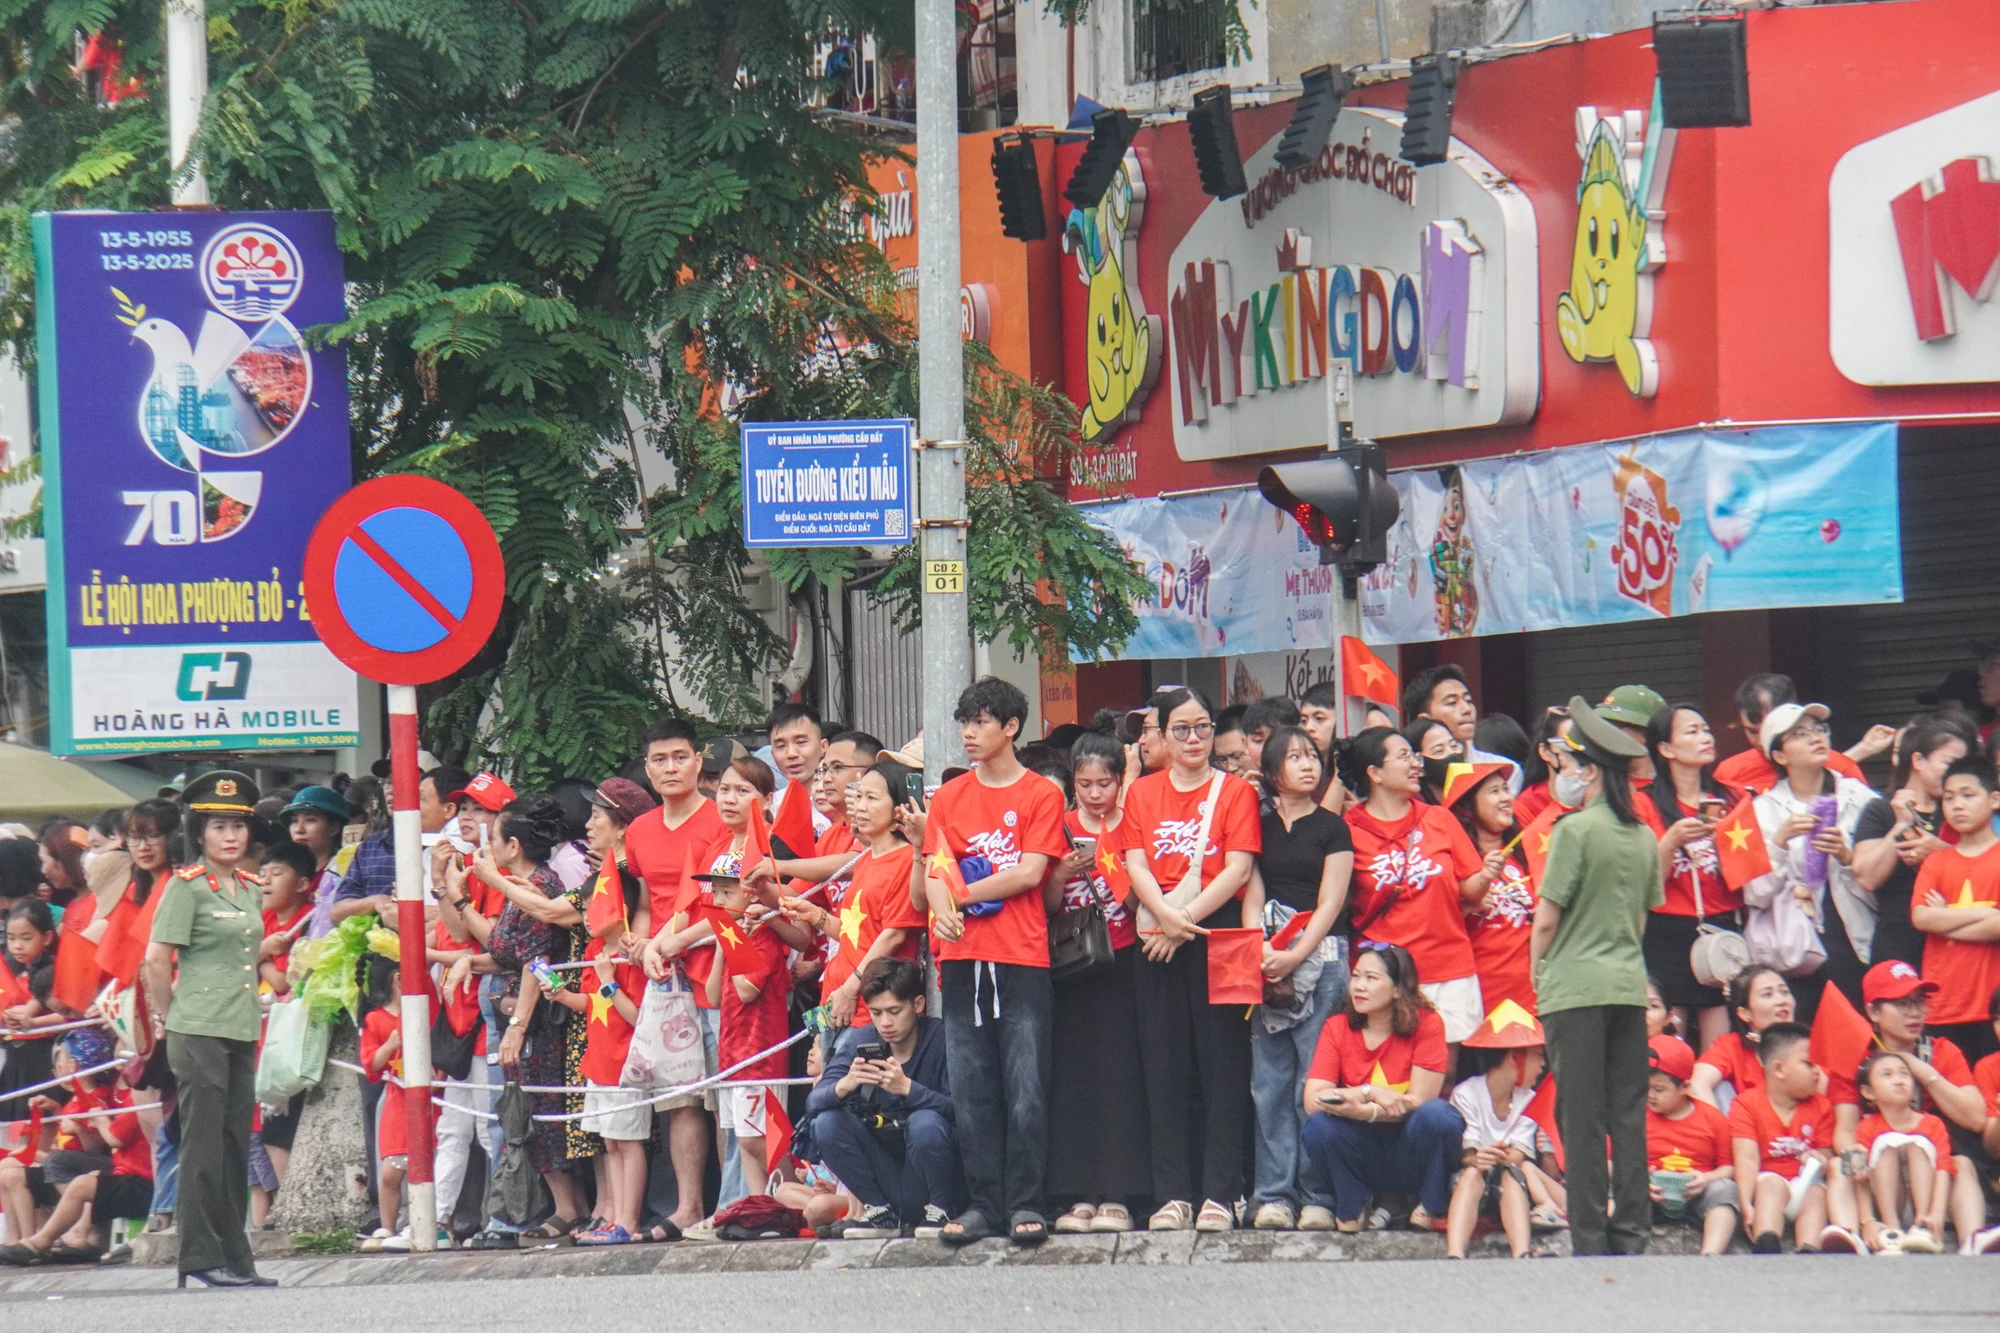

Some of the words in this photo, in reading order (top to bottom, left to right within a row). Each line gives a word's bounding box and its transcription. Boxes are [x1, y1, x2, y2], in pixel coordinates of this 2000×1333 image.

[100, 230, 193, 248] 13-5-1955
[101, 253, 194, 271] 13-5-2025
[778, 435, 792, 446] BAN
[793, 433, 812, 445] NHÂN
[813, 432, 827, 445] DÂN
[796, 459, 837, 503] ĐƯỜNG
[840, 452, 868, 502] KIỂU
[870, 452, 898, 502] MẪU
[122, 490, 197, 546] 70
[951, 563, 957, 573] 2
[81, 569, 104, 626] LỄ
[107, 575, 138, 634] HỘI
[142, 583, 179, 625] HOA
[181, 577, 255, 632] PHƯỢNG
[258, 566, 283, 622] ĐỎ
[94, 709, 184, 732] HOÀNG
[194, 707, 231, 729] HÀ
[241, 709, 341, 729] MOBILE
[75, 738, 221, 751] www.hoanghamobile.com
[258, 736, 300, 746] Hotline:
[303, 735, 357, 745] 1900.2091
[746, 1095, 760, 1118] 7
